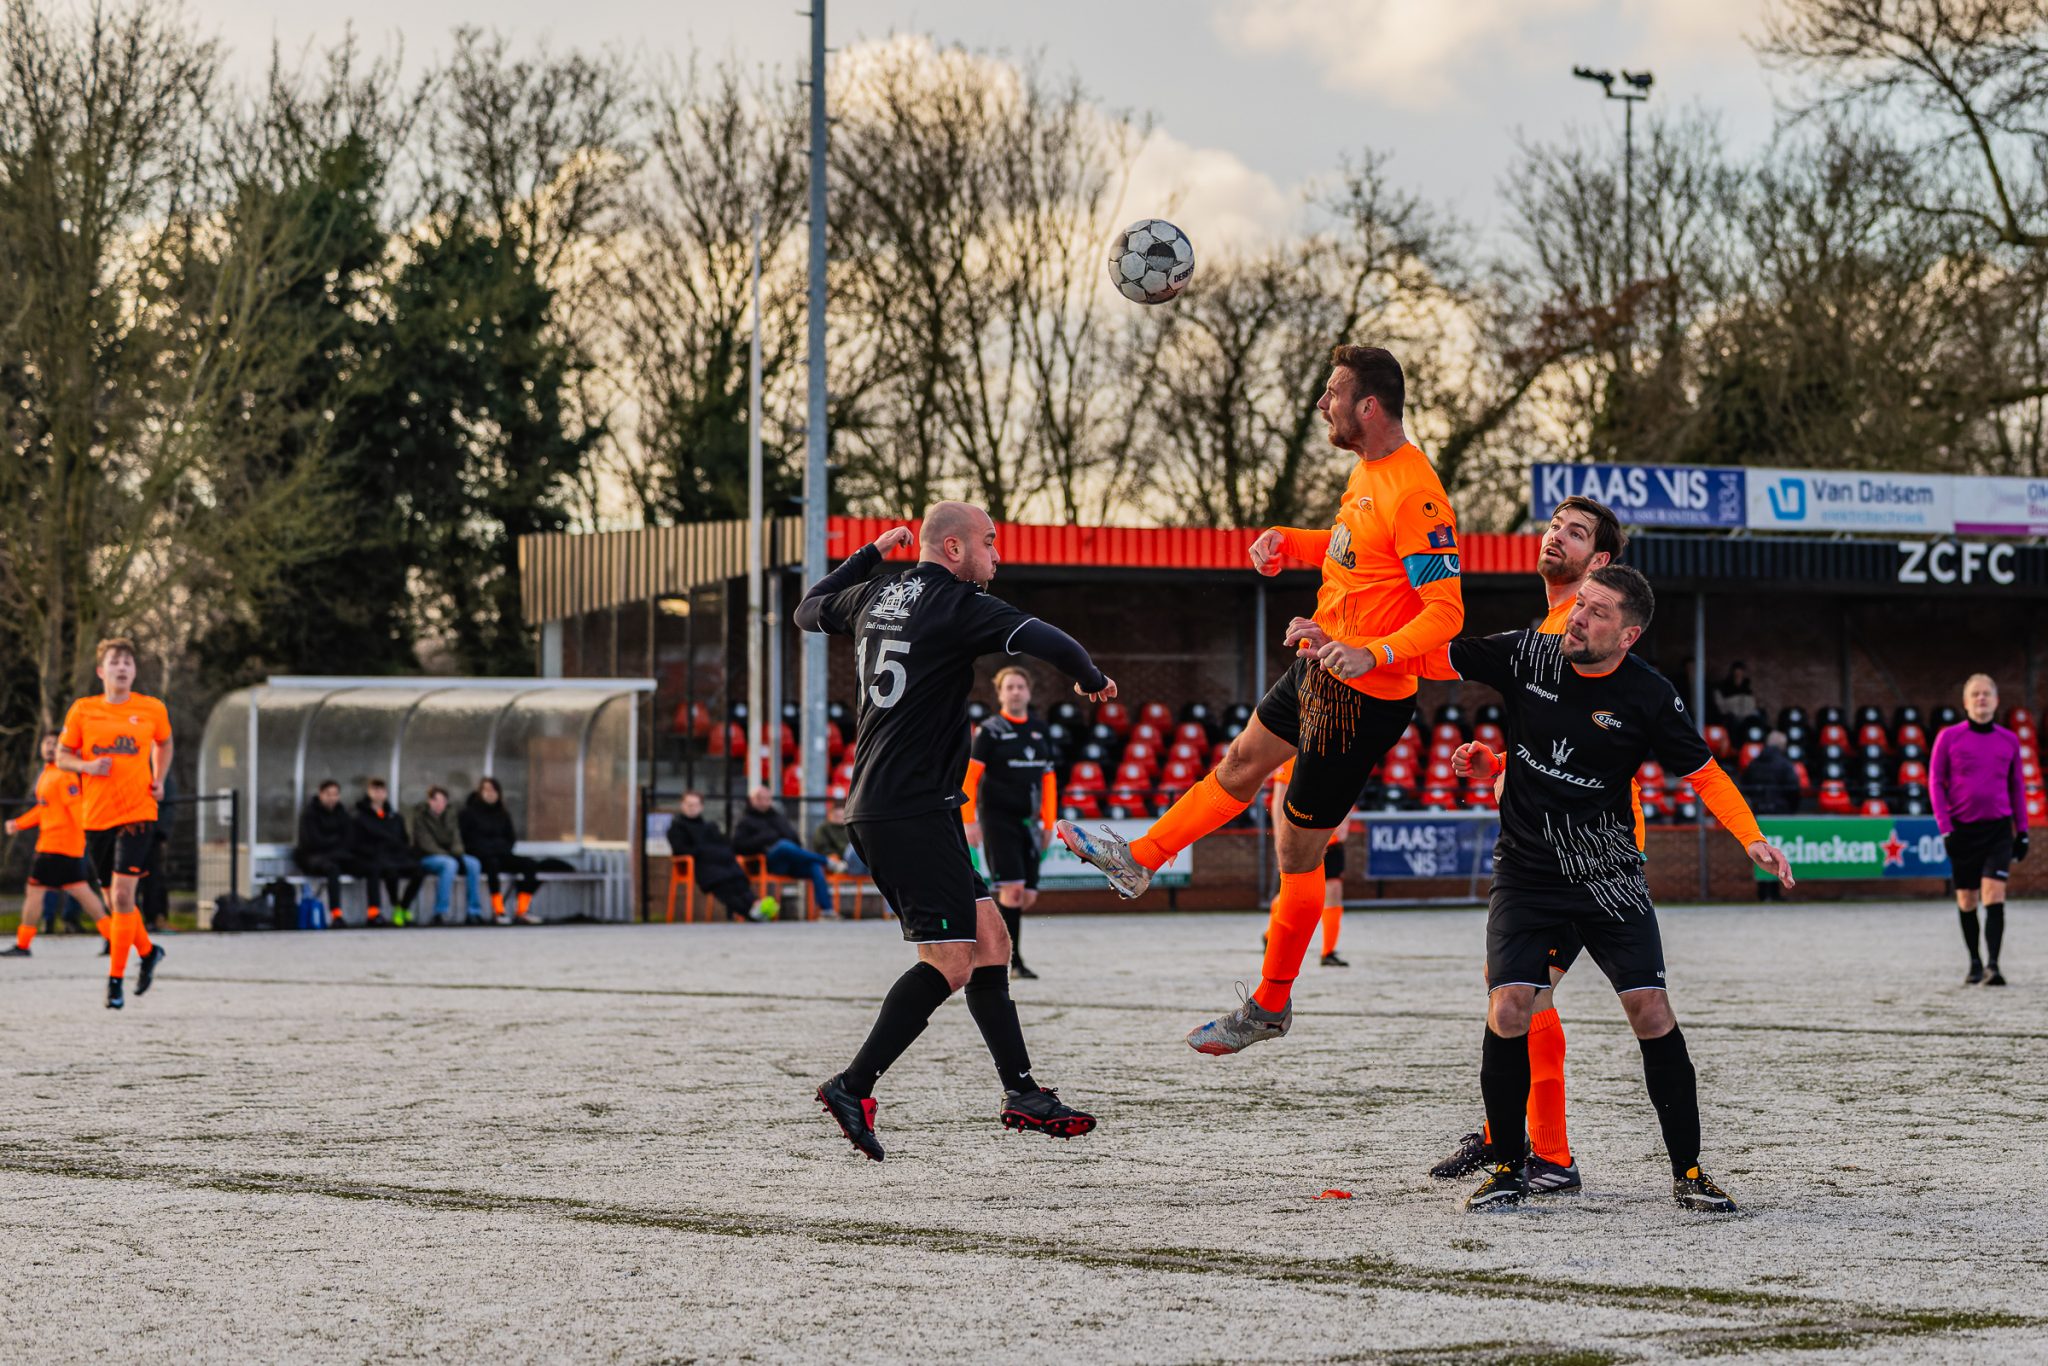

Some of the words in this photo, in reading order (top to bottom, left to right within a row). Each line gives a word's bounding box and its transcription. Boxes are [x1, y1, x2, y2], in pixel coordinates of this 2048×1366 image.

[1542, 466, 1649, 508] KLAAS
[1655, 470, 1709, 510] VIS
[1812, 479, 1853, 502] Van
[1858, 480, 1934, 505] Dalsem
[1898, 541, 2015, 584] ZCFC
[857, 637, 911, 708] 15
[1526, 682, 1559, 702] uhlsport
[1603, 716, 1622, 728] ZCFC
[1516, 743, 1605, 789] Maserati
[1372, 825, 1437, 851] KLAAS
[1404, 852, 1437, 876] VIS
